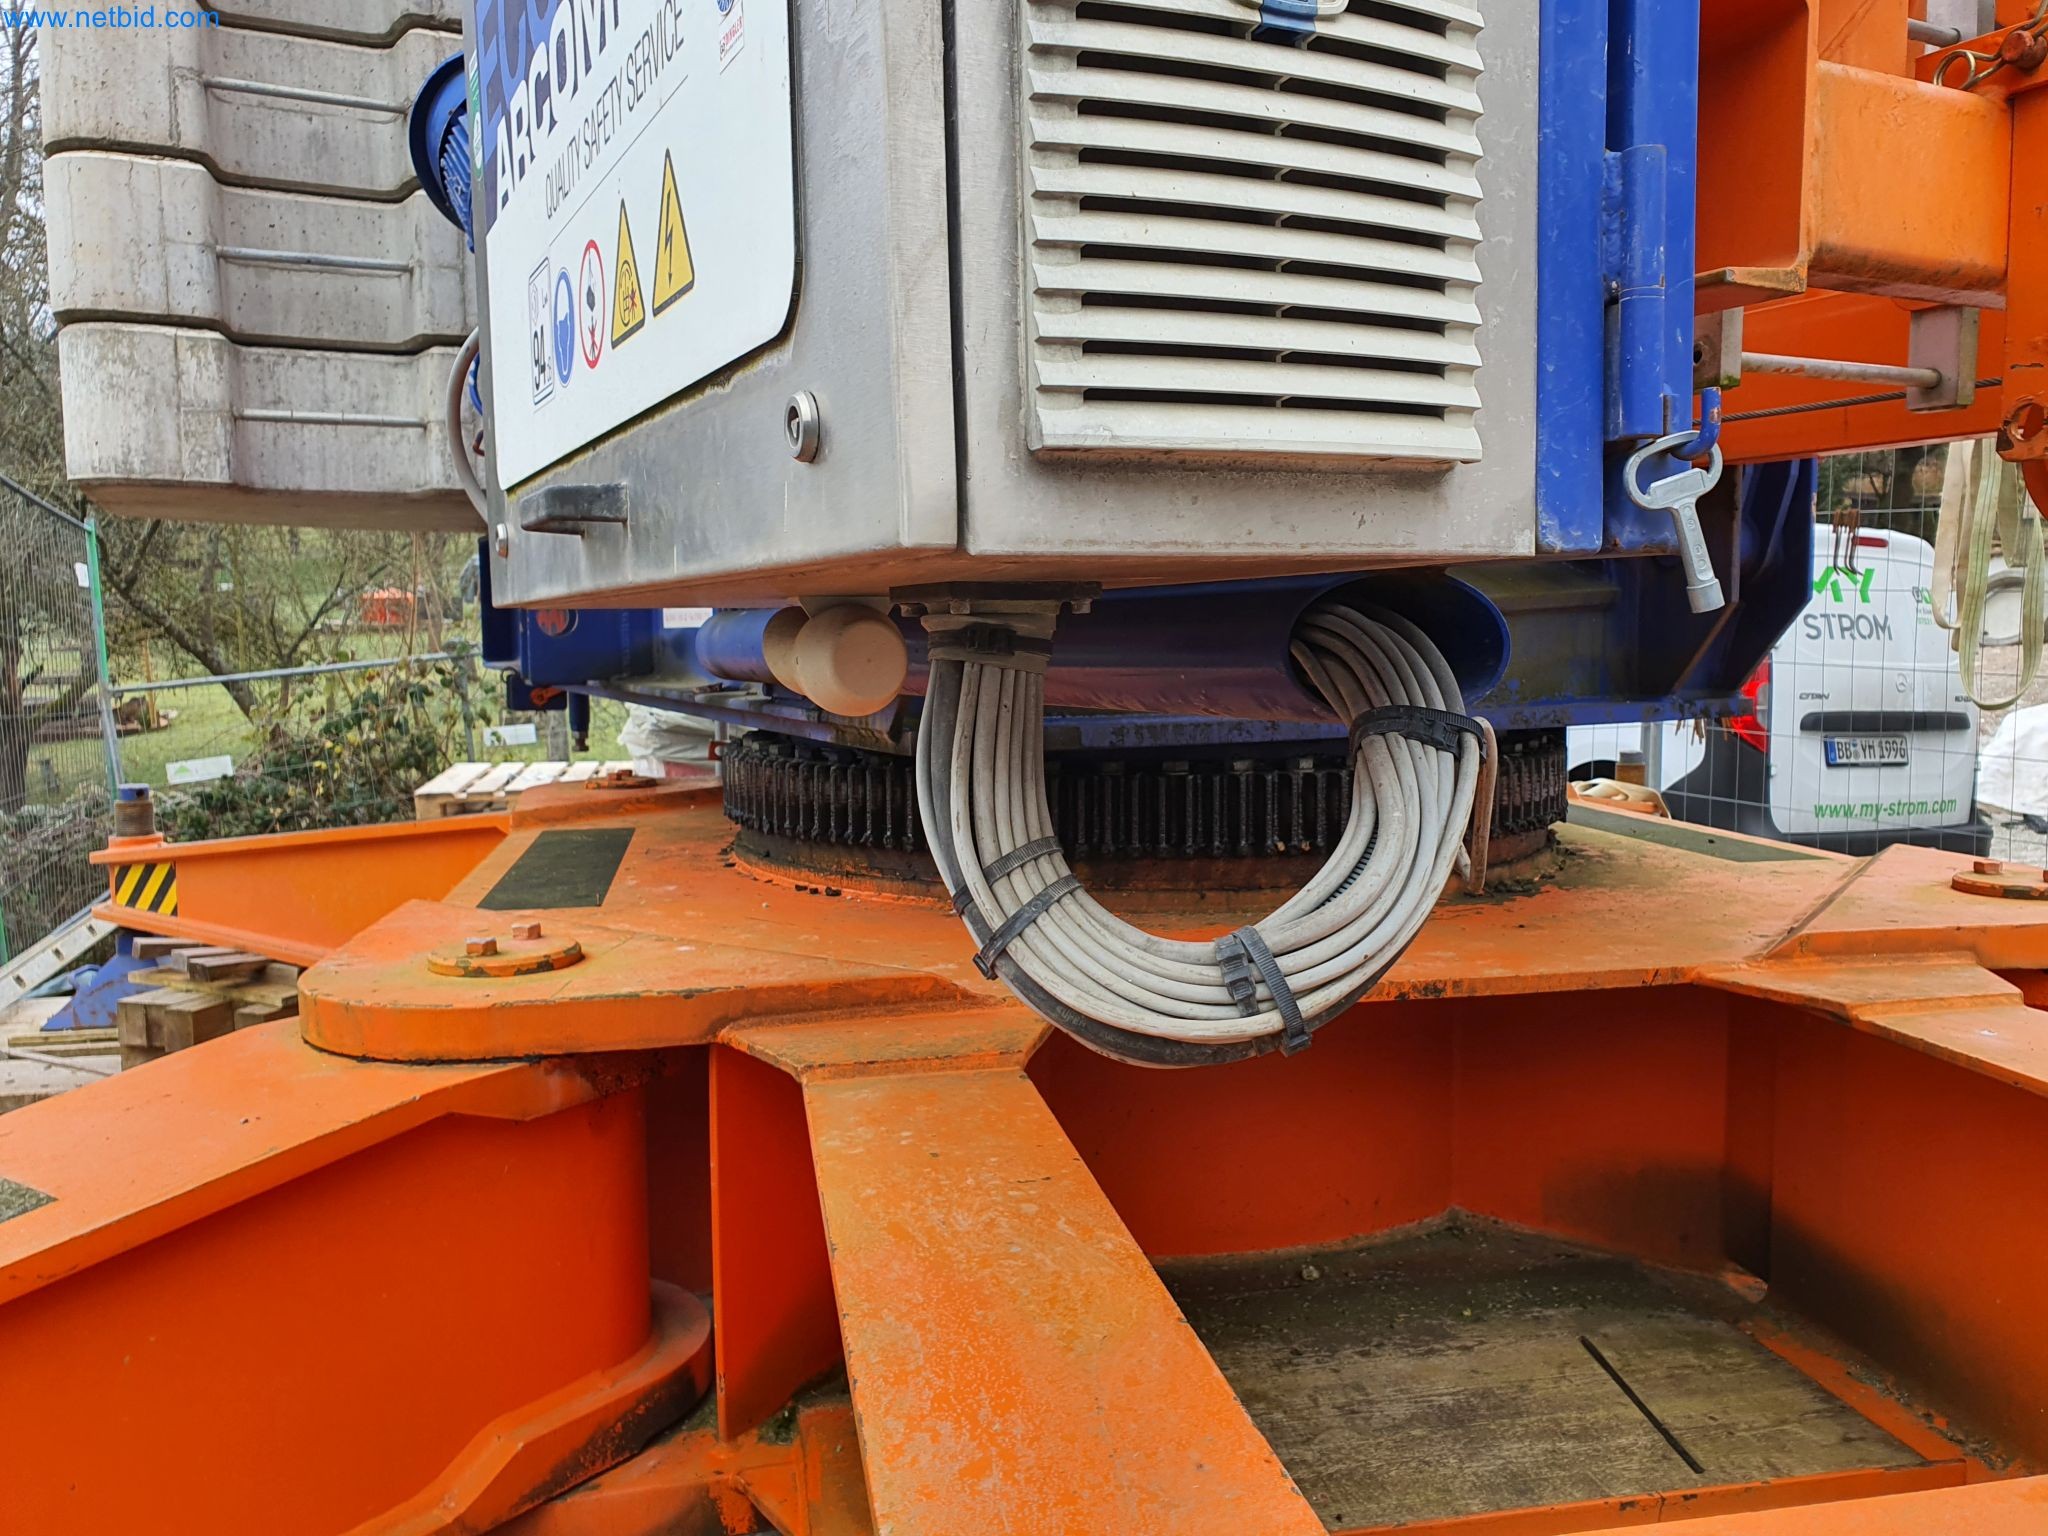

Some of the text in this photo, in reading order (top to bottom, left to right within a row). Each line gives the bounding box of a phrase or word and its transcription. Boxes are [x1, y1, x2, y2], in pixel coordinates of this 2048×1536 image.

[545, 0, 685, 220] QUALITY SAFETY SERVICE
[533, 324, 546, 391] 94
[1803, 613, 1893, 641] STROM
[1836, 741, 1852, 760] BB
[1878, 740, 1906, 760] 1996
[1814, 798, 1957, 822] www.my-strom.com
